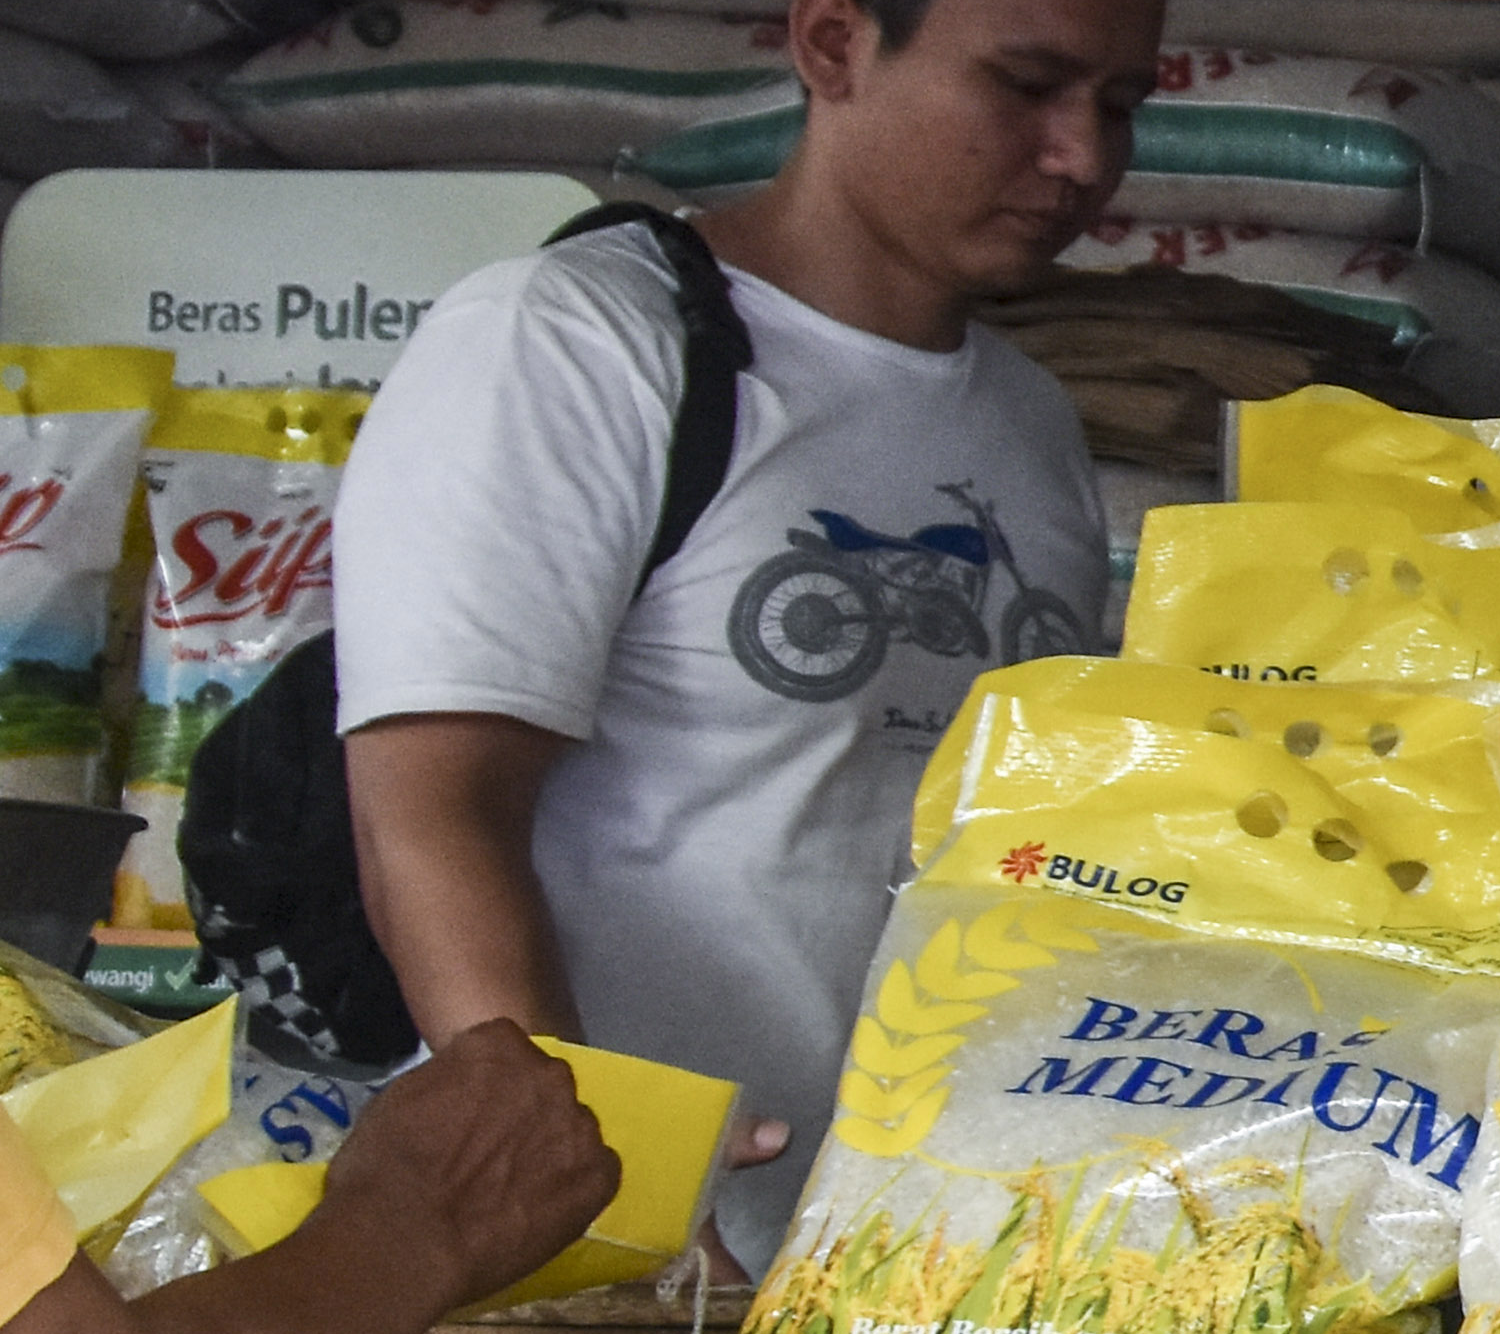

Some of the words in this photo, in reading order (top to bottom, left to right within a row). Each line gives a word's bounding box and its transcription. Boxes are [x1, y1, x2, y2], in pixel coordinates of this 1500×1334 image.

[148, 290, 262, 334] Beras
[1047, 854, 1190, 903] BULOG
[1062, 996, 1390, 1063] BERA
[1004, 1054, 1482, 1191] MEDIUM
